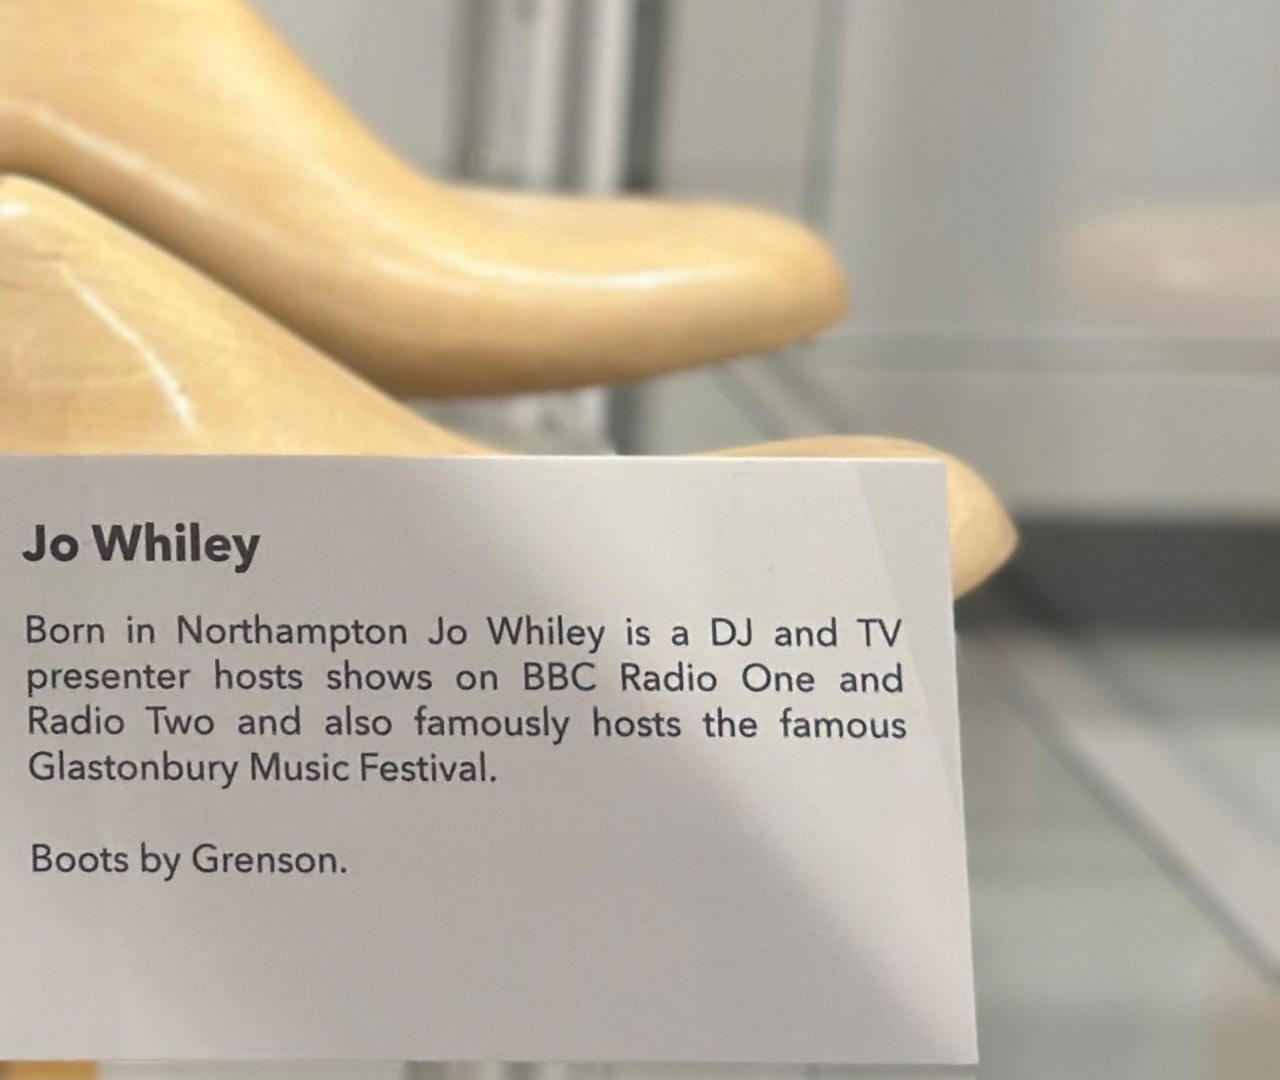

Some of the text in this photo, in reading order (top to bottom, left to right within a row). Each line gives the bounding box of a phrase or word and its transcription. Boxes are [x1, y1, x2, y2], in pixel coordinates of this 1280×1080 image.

[21, 521, 262, 574] Jo Whiley
[26, 612, 903, 655] Born in Northampton Jo Whiley is a DJ and TV
[26, 658, 904, 699] presenter hosts shows on BBC Radio One and
[28, 703, 908, 747] Radio Two and also famously hosts the famous
[28, 748, 497, 791] Glastonbury Music Festival.
[31, 840, 348, 883] Boots by Grenson.
